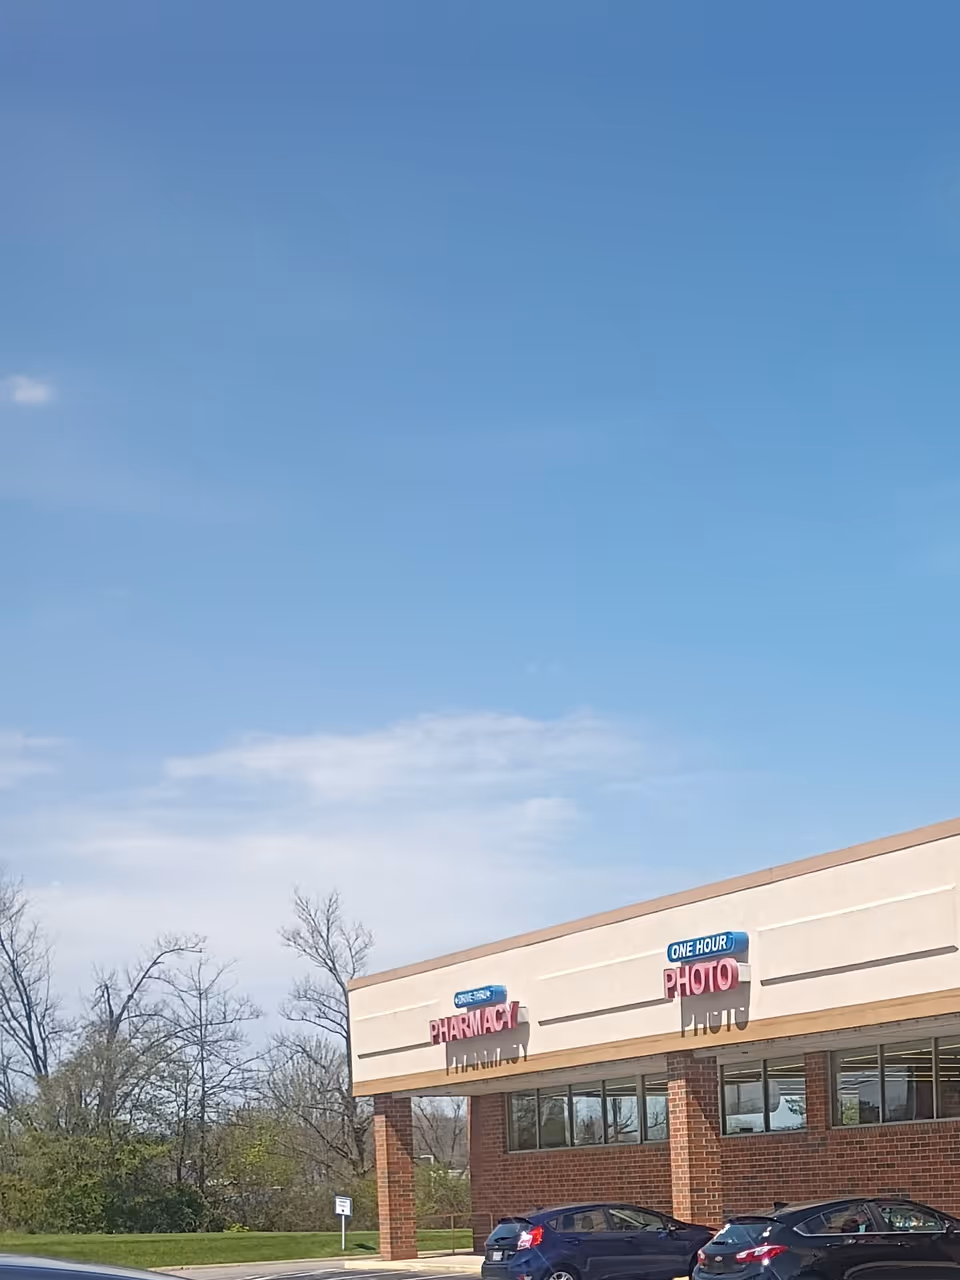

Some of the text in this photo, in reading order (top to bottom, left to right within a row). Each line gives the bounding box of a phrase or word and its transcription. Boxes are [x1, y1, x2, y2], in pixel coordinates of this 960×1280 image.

[671, 934, 727, 960] ONE HOUR
[664, 957, 738, 999] PHOTO
[430, 1001, 518, 1045] PHARMACY
